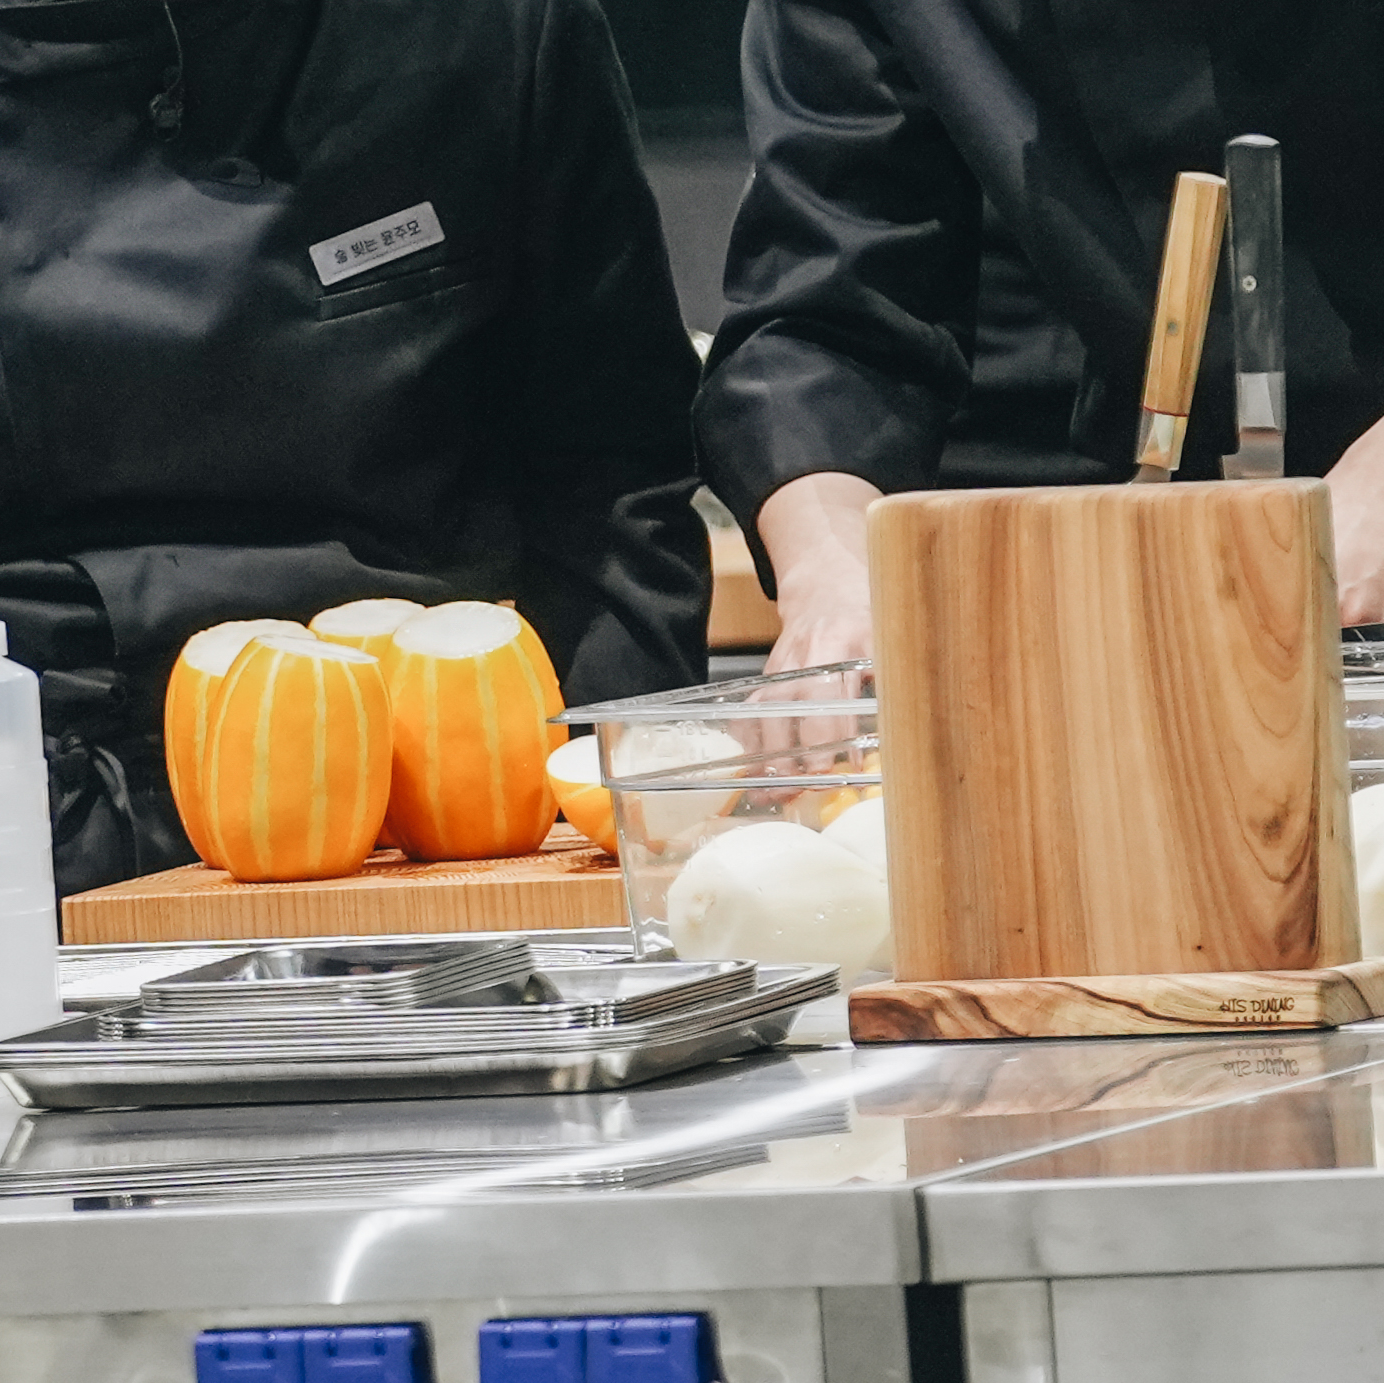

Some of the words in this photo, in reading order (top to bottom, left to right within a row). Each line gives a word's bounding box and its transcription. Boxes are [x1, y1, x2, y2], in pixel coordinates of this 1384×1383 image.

[335, 250, 348, 264] 술
[380, 220, 422, 246] 윤주모
[1250, 996, 1295, 1014] DINING
